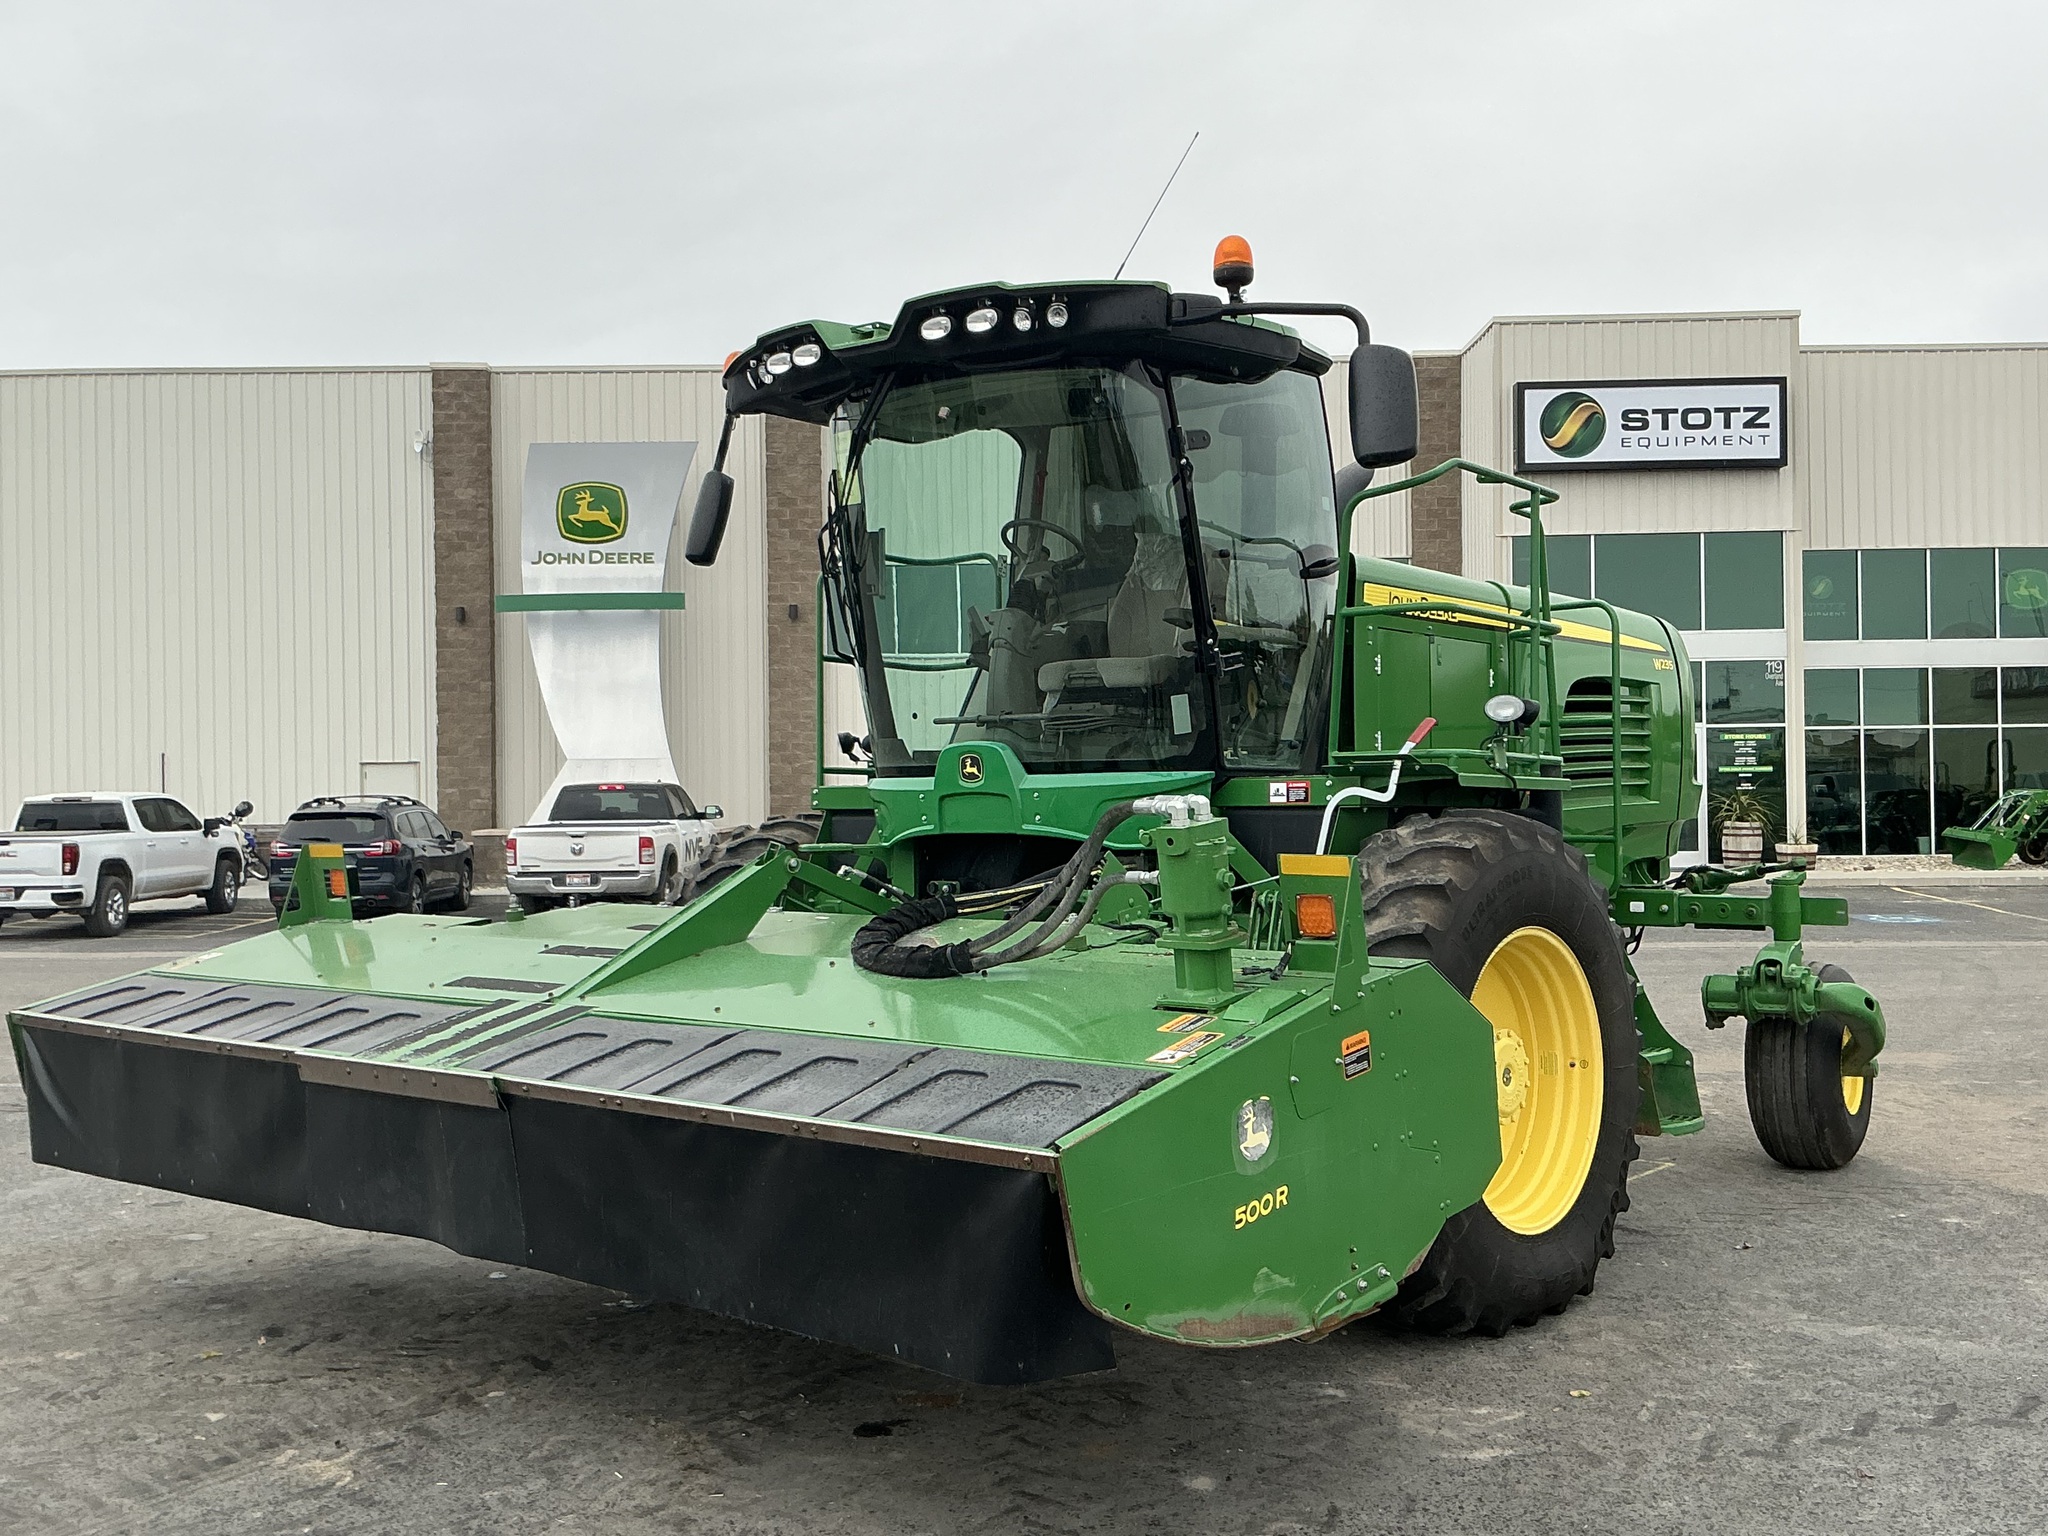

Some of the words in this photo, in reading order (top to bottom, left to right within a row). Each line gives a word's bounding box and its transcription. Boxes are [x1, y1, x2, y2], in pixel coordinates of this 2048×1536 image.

[1621, 406, 1770, 431] STOTZ
[1620, 435, 1771, 450] EQUIPMENT
[531, 550, 585, 565] JOHN
[589, 550, 655, 565] DEERE
[1765, 660, 1783, 673] 119
